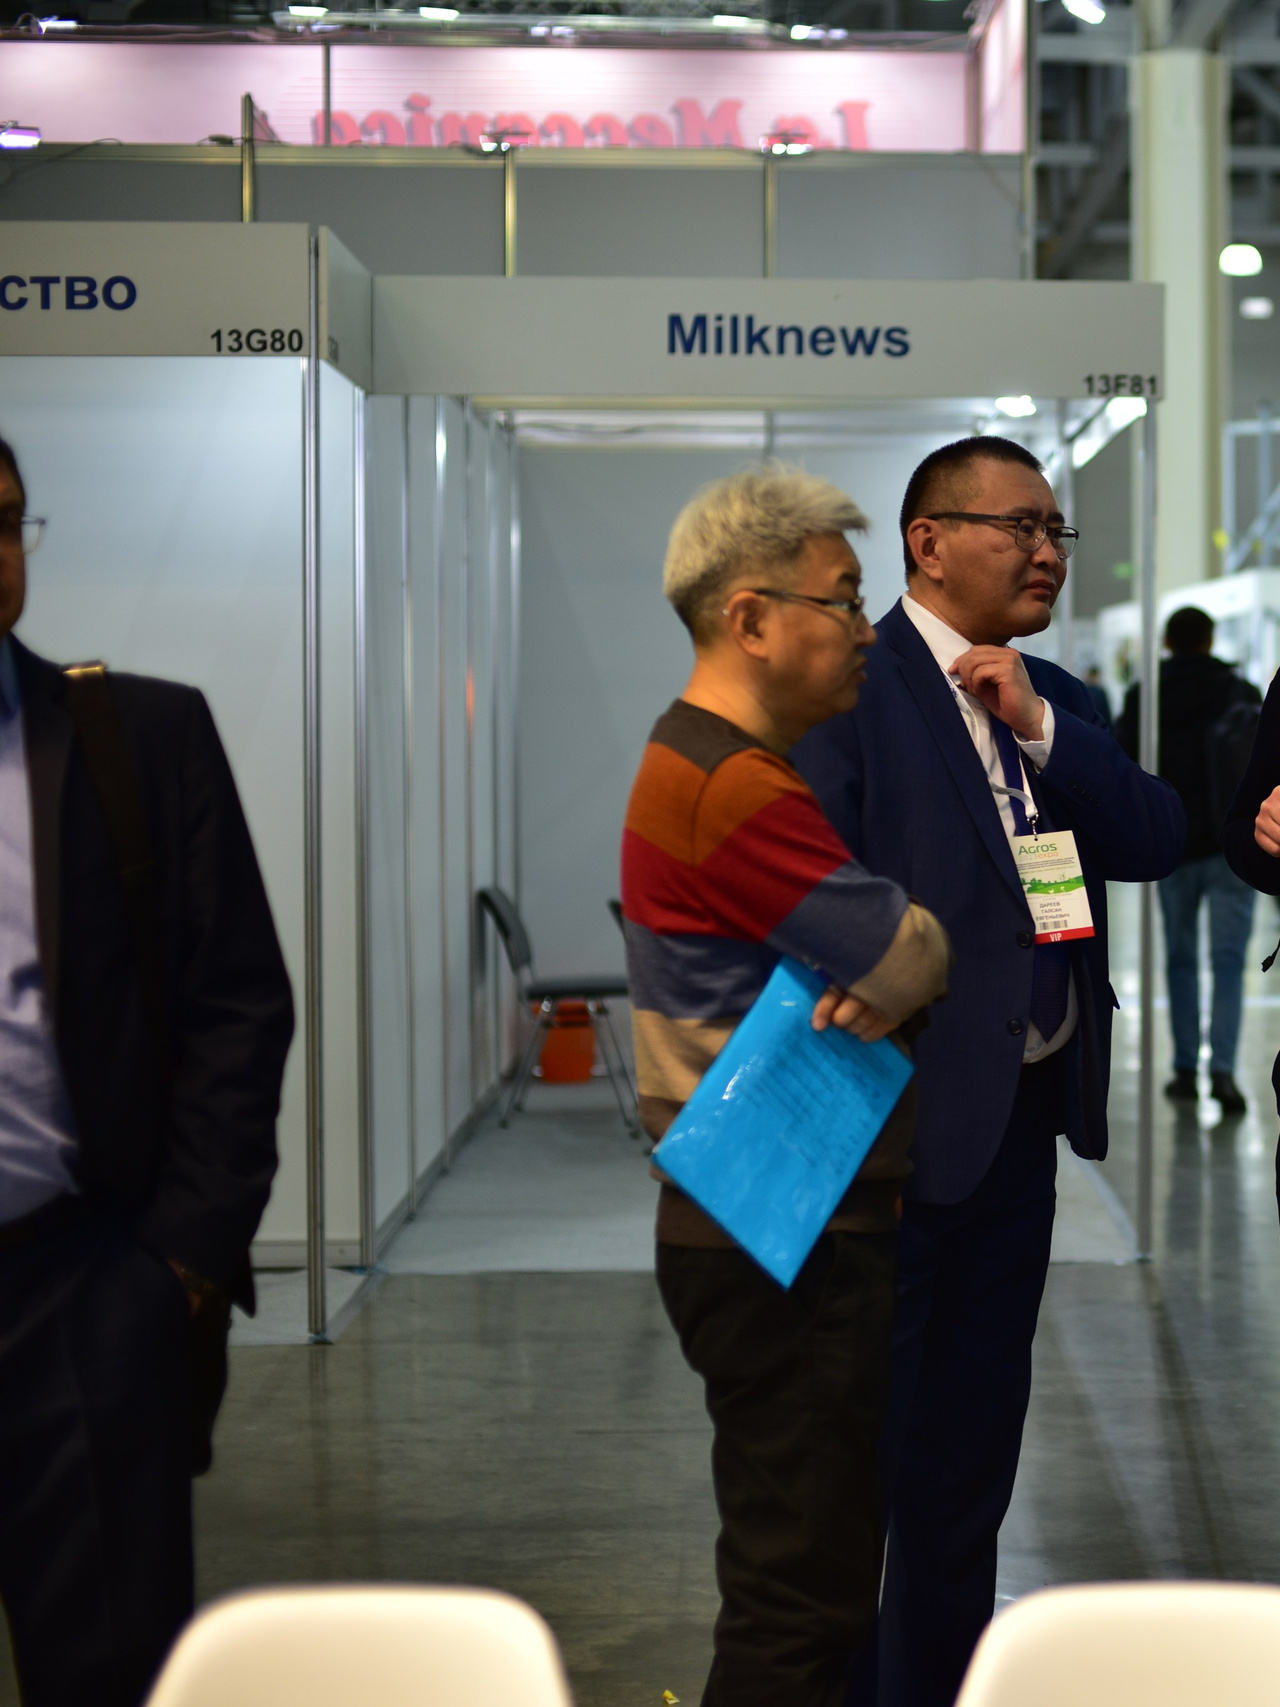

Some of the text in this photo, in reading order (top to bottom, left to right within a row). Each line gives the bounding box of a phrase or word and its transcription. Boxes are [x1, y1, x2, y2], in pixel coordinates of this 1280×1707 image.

[210, 328, 304, 353] 13G80
[668, 313, 911, 357] Milknews
[1084, 374, 1157, 396] 13F81
[1049, 933, 1062, 942] VIP
